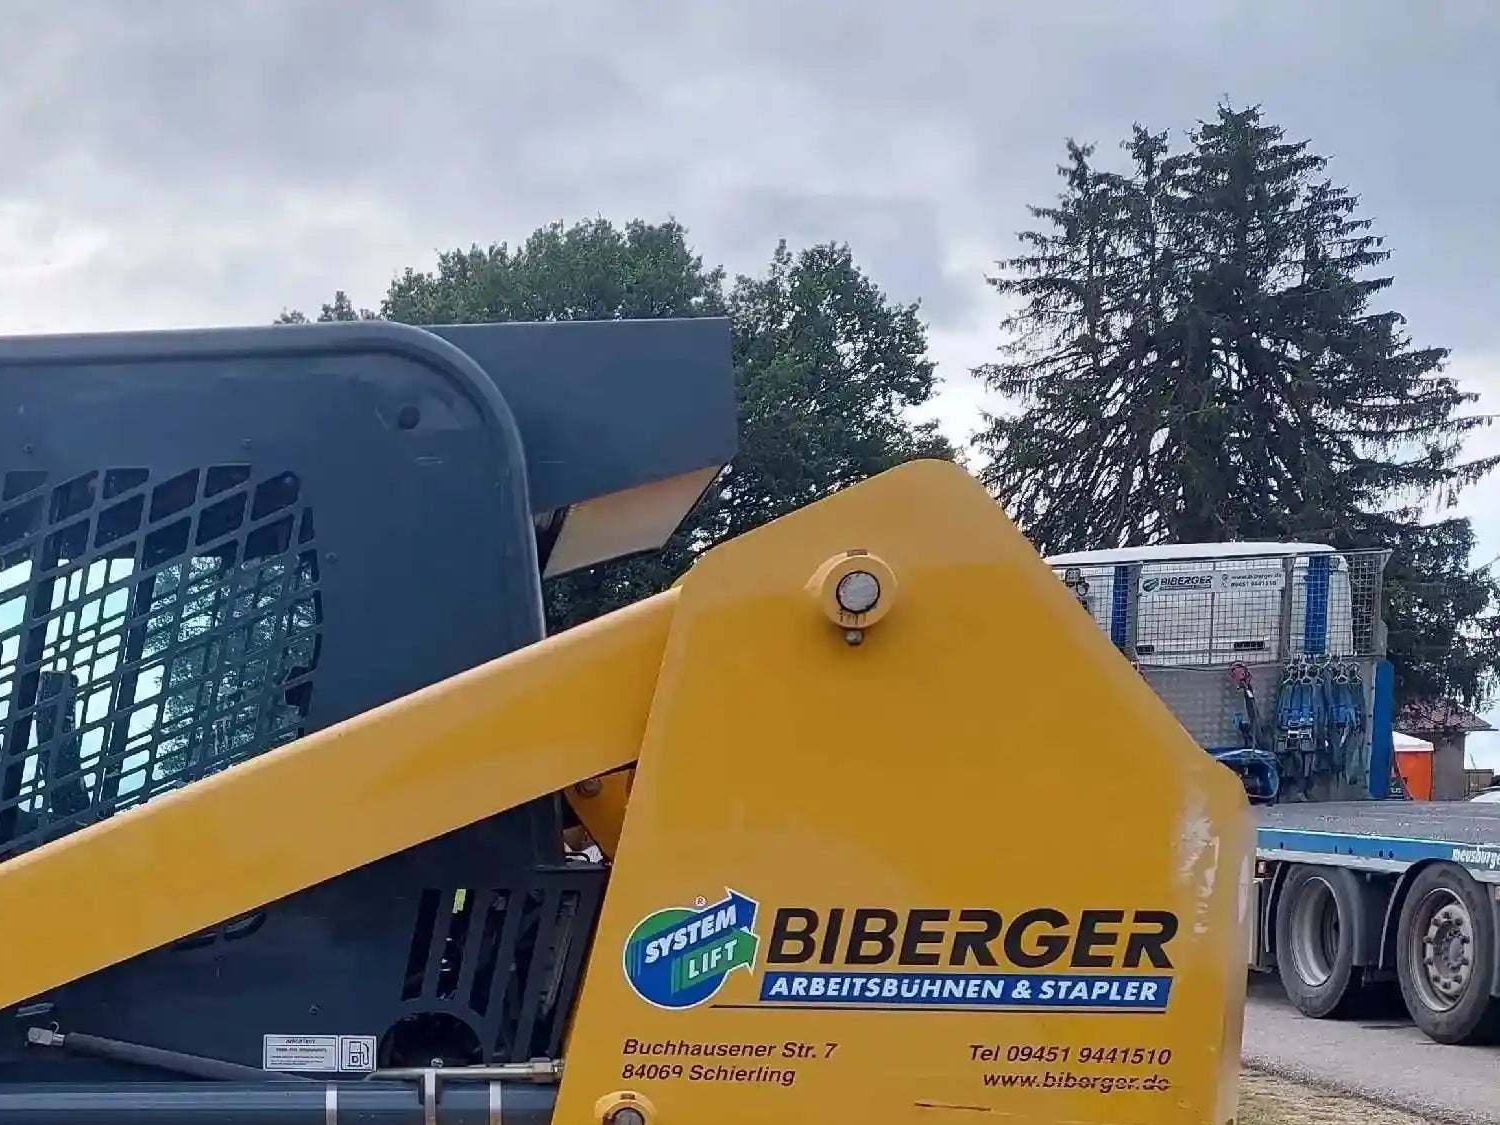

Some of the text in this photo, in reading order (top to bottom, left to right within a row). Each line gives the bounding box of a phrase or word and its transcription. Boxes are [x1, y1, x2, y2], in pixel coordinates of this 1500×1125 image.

[1160, 576, 1213, 586] BIBERGER
[645, 904, 737, 964] SYSTEM
[766, 908, 1179, 969] BIBERGER
[688, 939, 738, 979] LIFT
[768, 976, 1158, 1001] ARBEITSBÜHNEN & STAPLER
[622, 1038, 839, 1059] Buchhausener Str. 7
[969, 1044, 1172, 1066] Tel 09451 9441510
[621, 1063, 797, 1087] 84069 Schierling
[983, 1071, 1172, 1093] www.biberger.de
